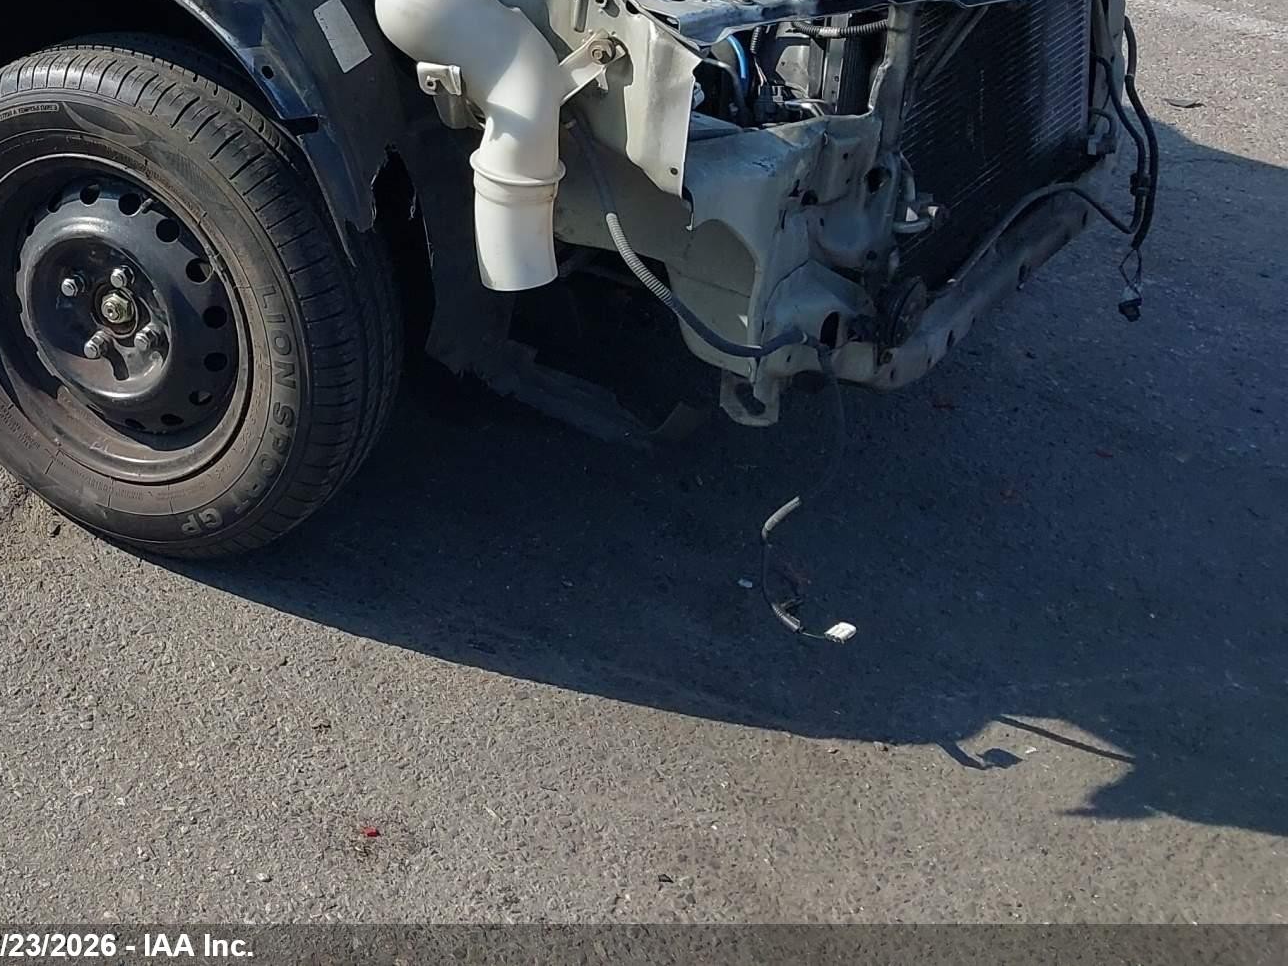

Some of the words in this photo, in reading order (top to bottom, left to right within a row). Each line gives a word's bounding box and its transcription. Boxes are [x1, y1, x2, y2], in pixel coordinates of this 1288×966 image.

[256, 285, 297, 390] LION
[229, 400, 296, 515] SPORT
[180, 507, 224, 536] GP
